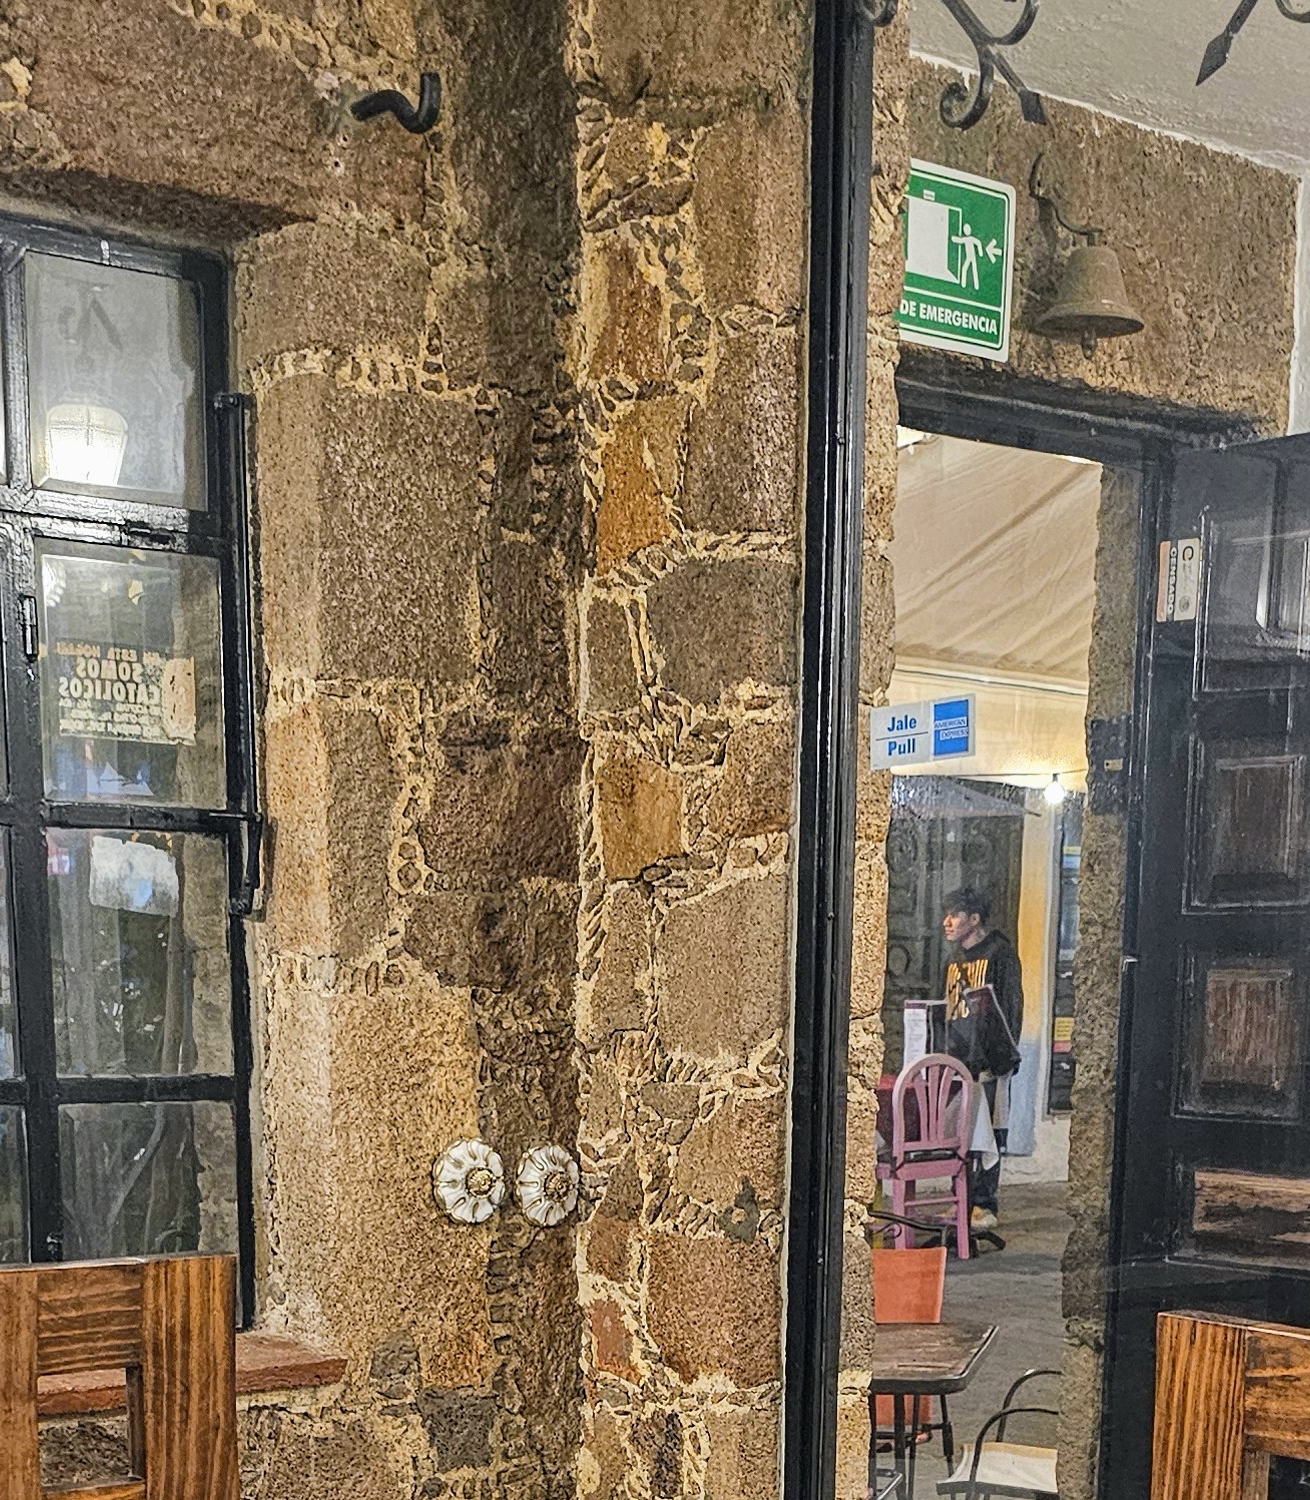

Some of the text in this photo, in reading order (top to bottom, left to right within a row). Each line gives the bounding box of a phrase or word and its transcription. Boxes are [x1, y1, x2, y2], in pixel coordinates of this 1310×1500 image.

[899, 300, 998, 336] DE EMERGENCIA
[1167, 546, 1178, 615] CENSADO
[887, 714, 917, 732] Jale
[934, 719, 967, 730] AMERICAN
[887, 738, 916, 756] Pull
